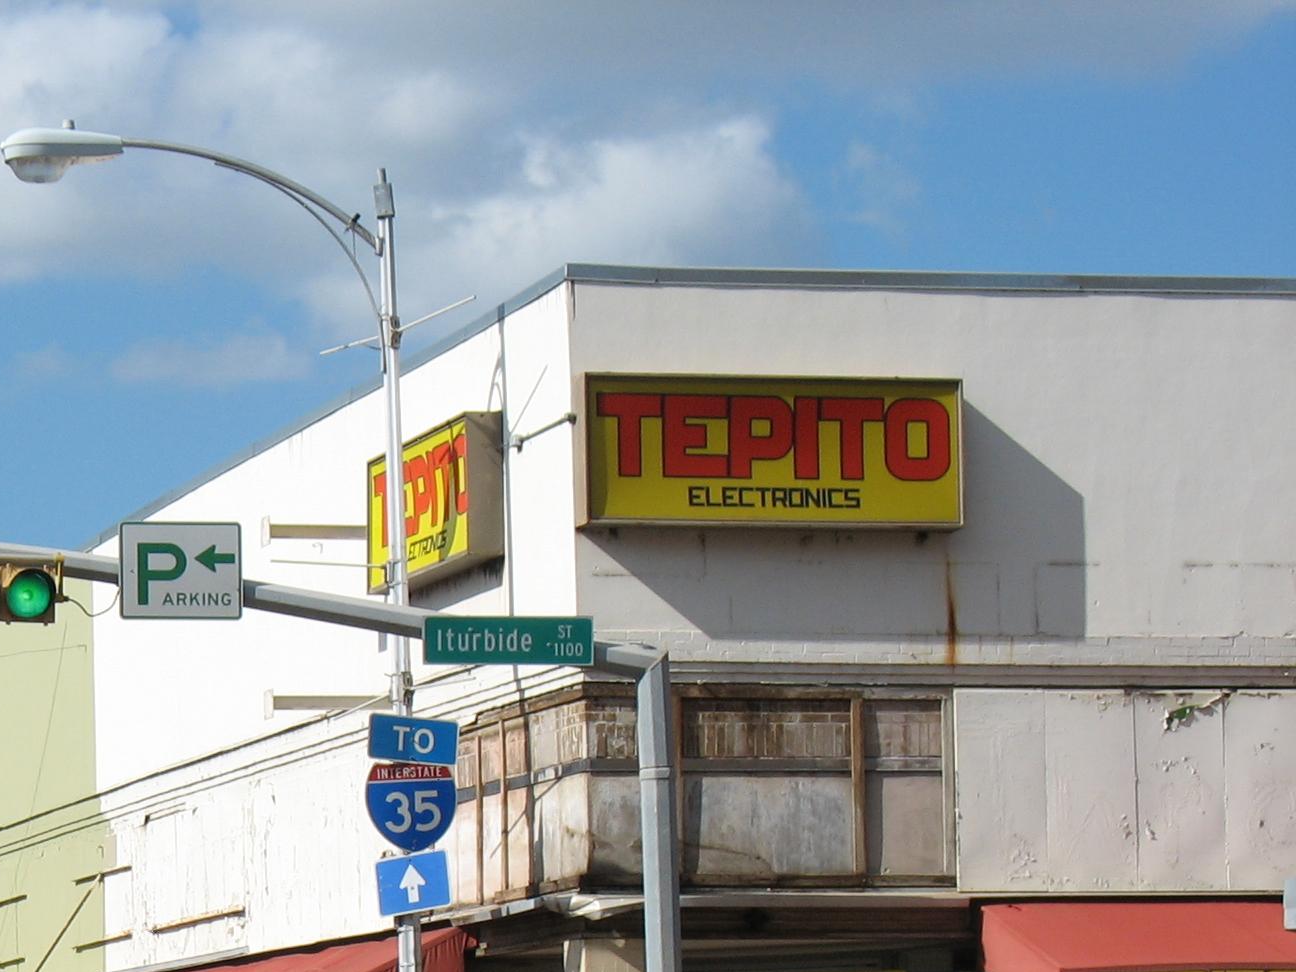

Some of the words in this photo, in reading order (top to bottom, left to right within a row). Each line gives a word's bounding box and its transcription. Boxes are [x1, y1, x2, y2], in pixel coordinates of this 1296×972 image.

[596, 393, 950, 481] TEPITO
[688, 486, 861, 508] ELECTRONICS
[437, 627, 533, 652] Iturbide
[558, 625, 572, 639] ST
[554, 642, 584, 657] 1100
[393, 725, 435, 755] TO
[376, 764, 443, 780] INTERSTATE
[384, 789, 442, 834] 35
